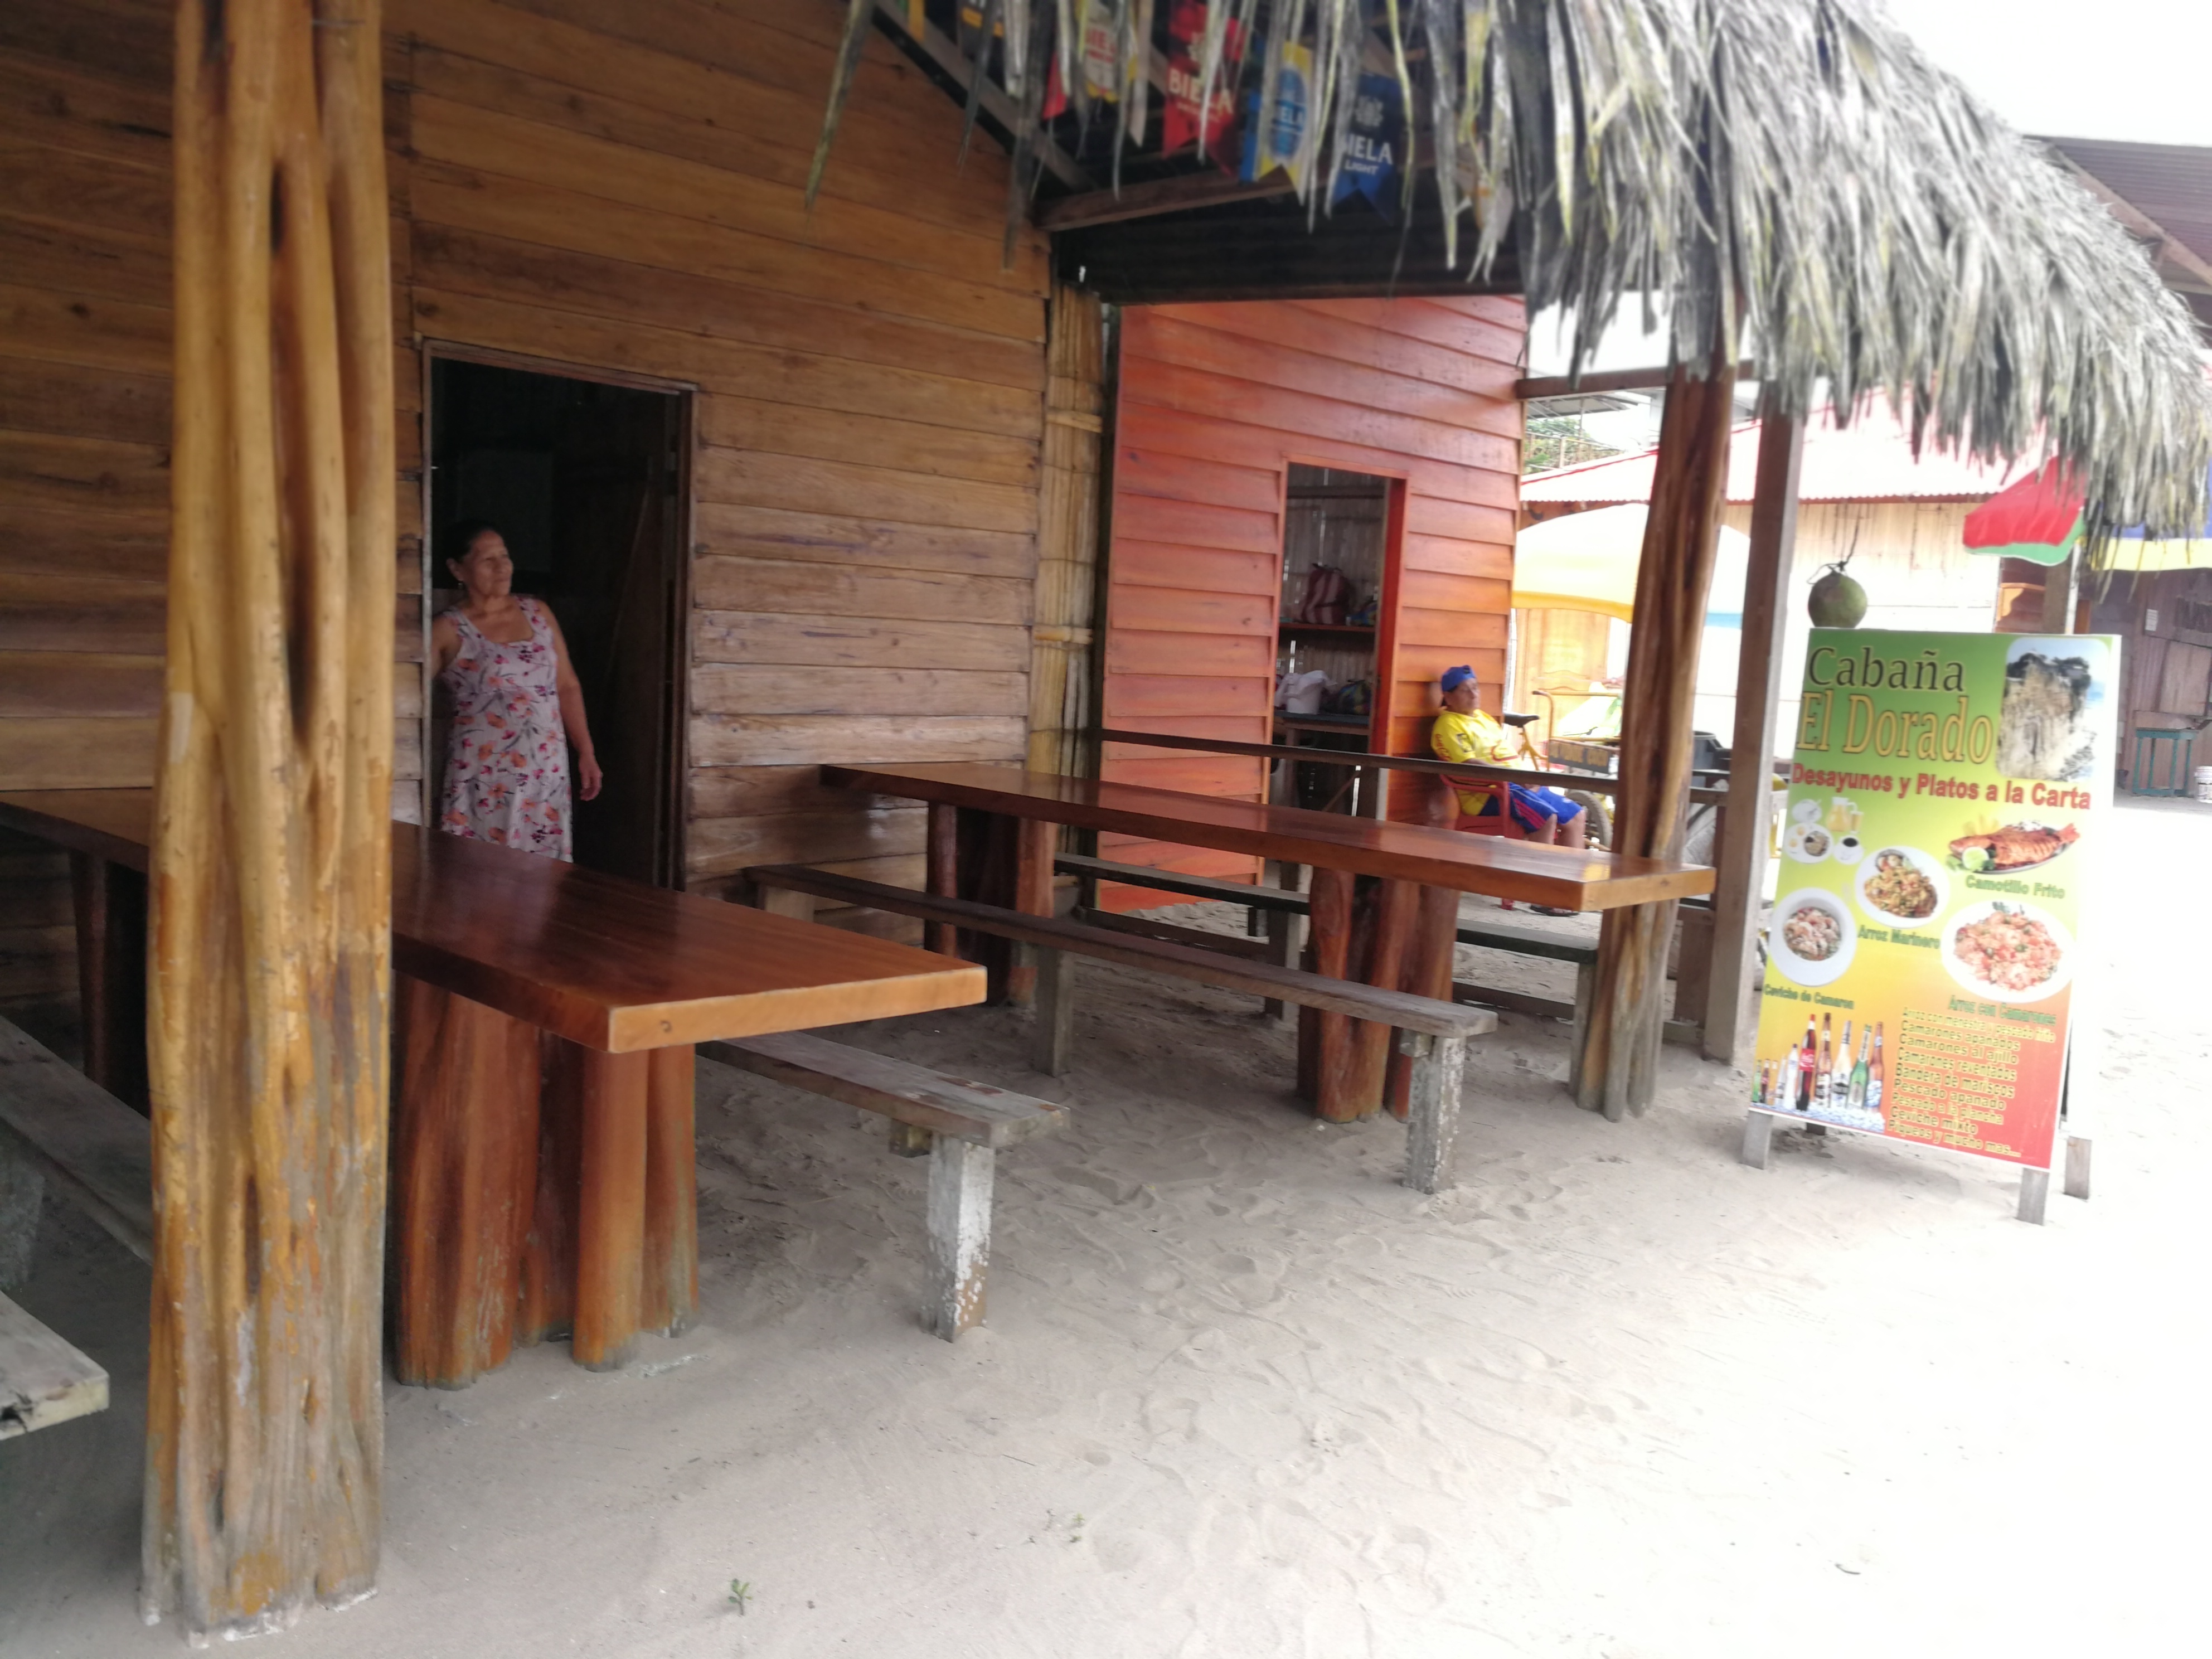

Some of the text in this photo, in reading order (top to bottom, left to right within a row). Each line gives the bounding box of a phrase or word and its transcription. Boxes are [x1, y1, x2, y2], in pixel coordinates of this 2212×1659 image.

[1168, 67, 1234, 114] BIEA
[1345, 133, 1393, 165] IELA
[1344, 159, 1379, 175] LIGHT
[1808, 647, 1965, 692] Cabaña
[1796, 688, 1994, 764] El Dorado
[1792, 763, 2092, 809] Desayunos y Platos a la Carta
[2033, 882, 2065, 899] Frito
[1857, 925, 1941, 949] Arroz Marinero
[1898, 1032, 1968, 1056] Camarones
[1970, 1045, 1985, 1059] al
[1900, 1019, 1962, 1041] Camarones
[1896, 1046, 1955, 1071] Camarones
[1893, 1078, 2007, 1111] Pescado apanado
[1895, 1061, 2016, 1099] Bandera de mariscos
[1891, 1091, 1937, 1112] Pescado
[1937, 1103, 1946, 1114] a
[1887, 1118, 1933, 1139] Piqueos
[1933, 1130, 1943, 1144] y
[1943, 1132, 1984, 1150] mucho
